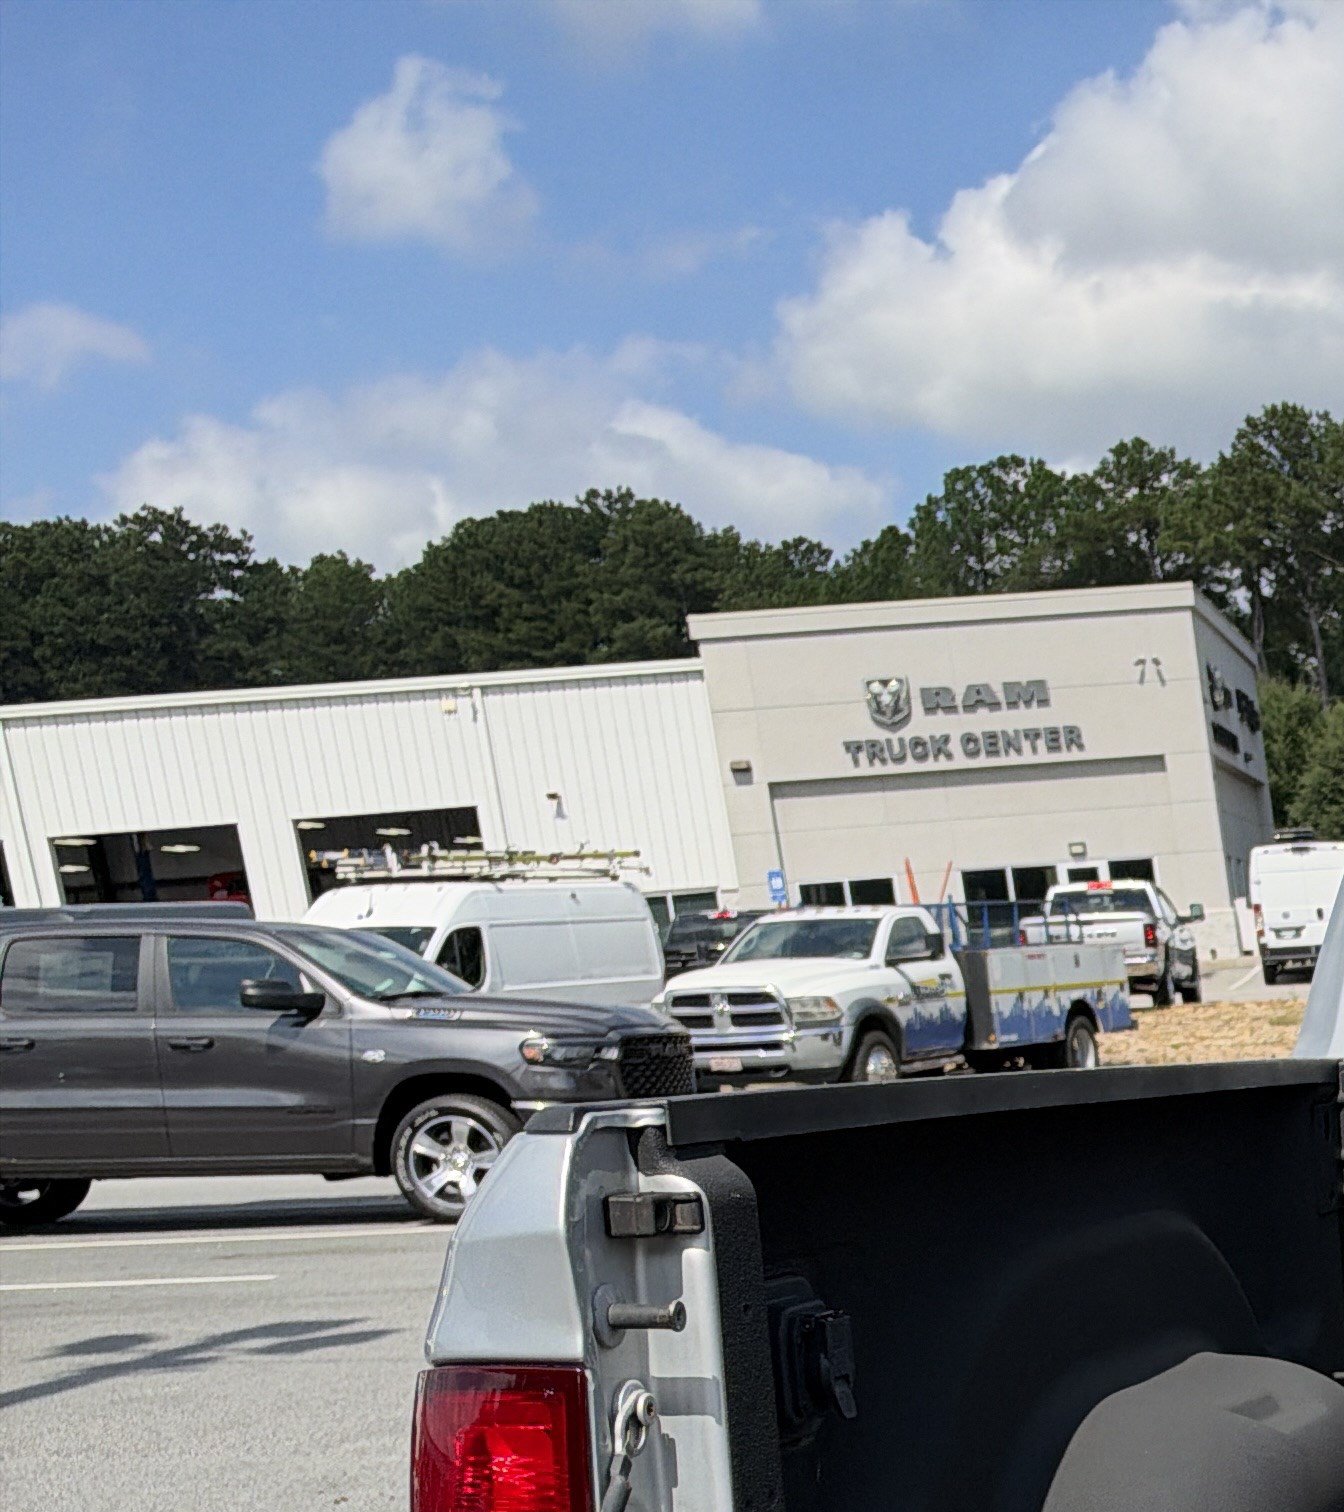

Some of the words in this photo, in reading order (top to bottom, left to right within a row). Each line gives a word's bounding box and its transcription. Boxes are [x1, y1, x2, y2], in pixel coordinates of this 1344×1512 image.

[920, 680, 1050, 713] RAM
[844, 734, 953, 767] TRUCK
[960, 726, 1085, 758] CENTER
